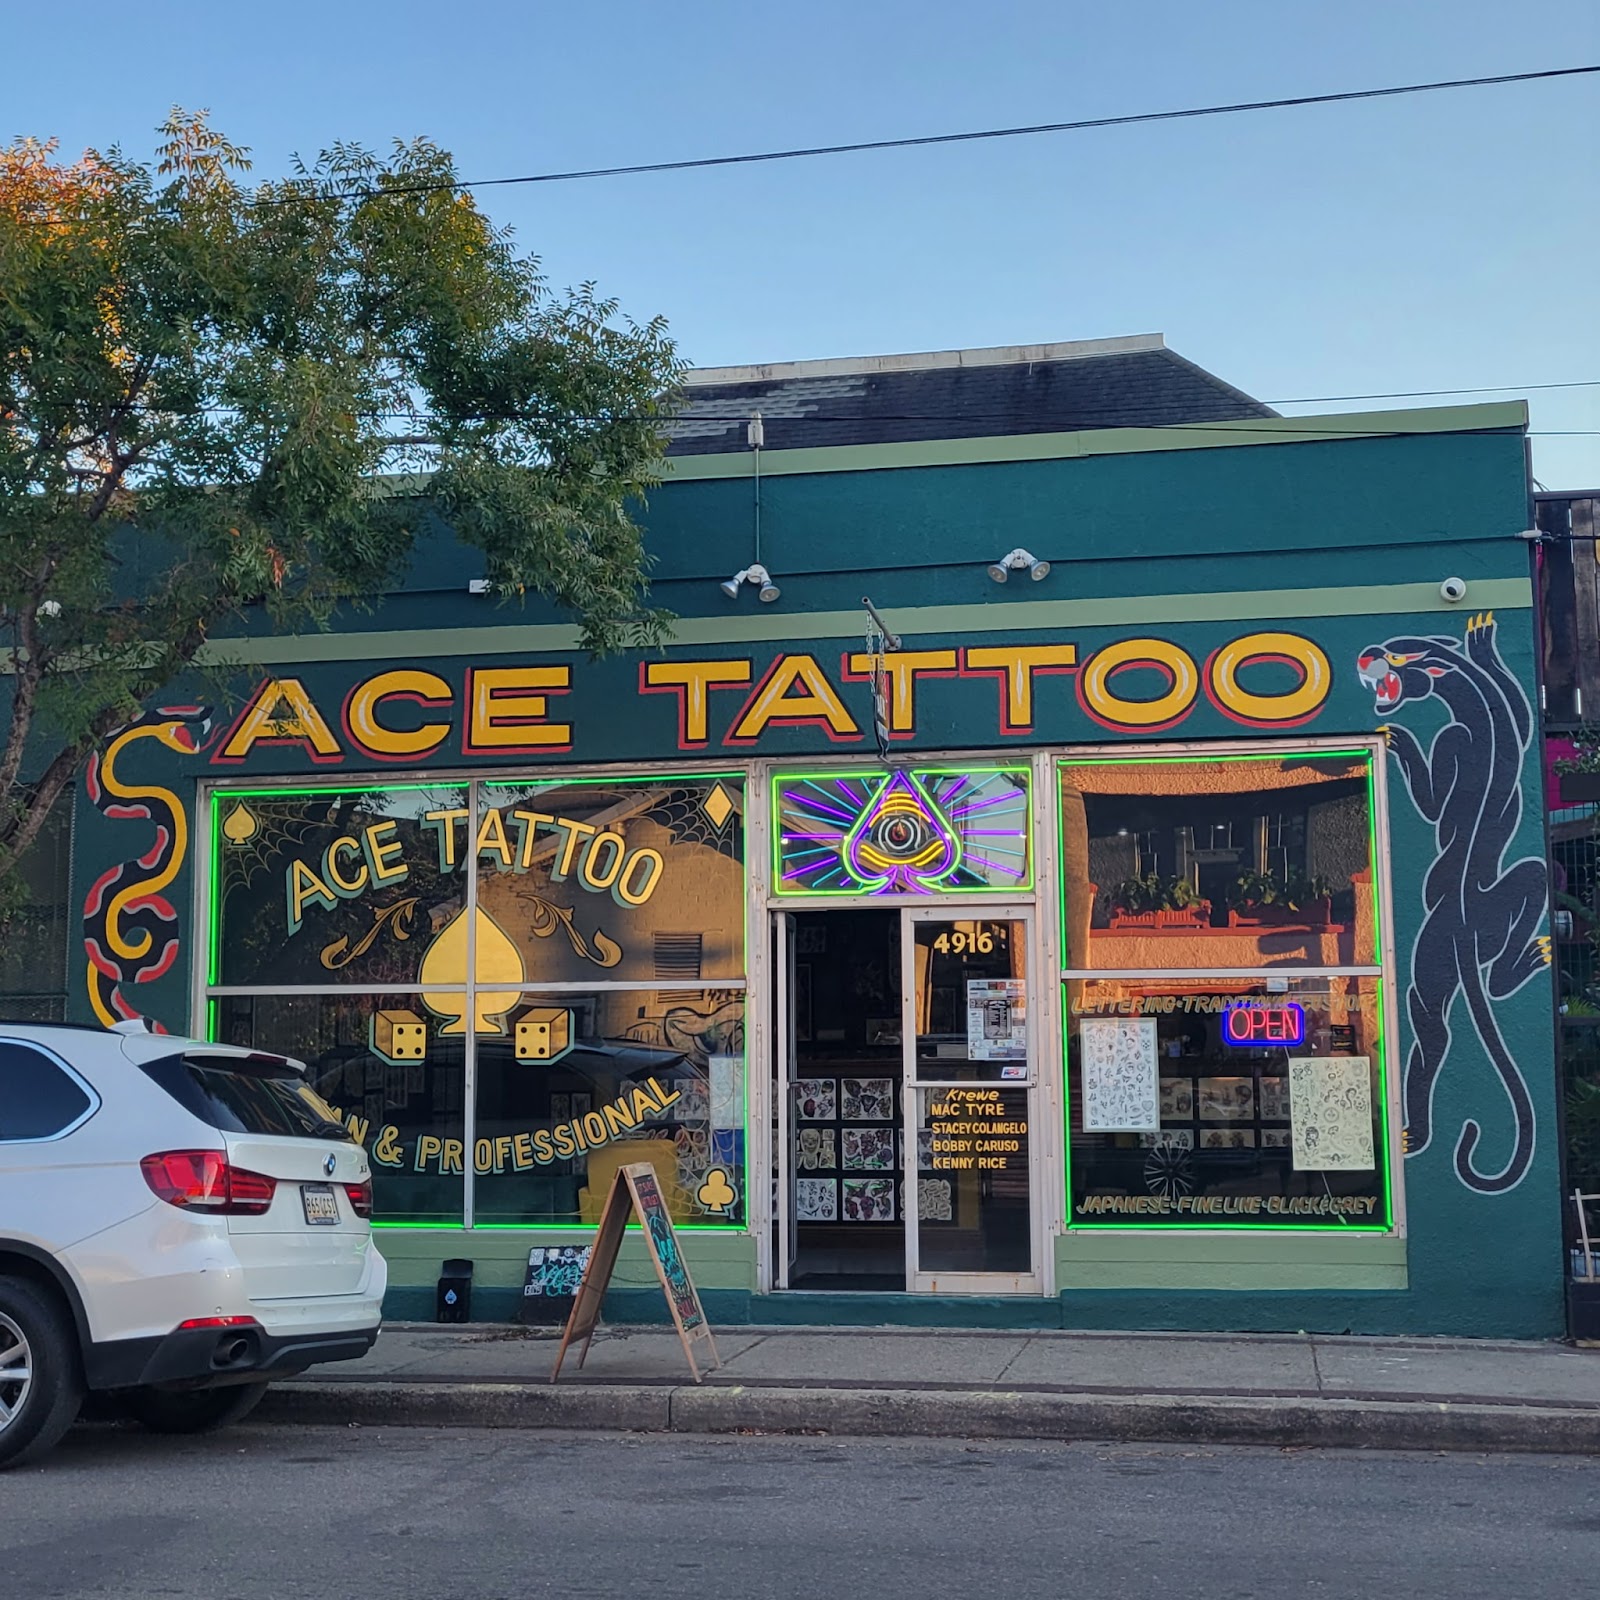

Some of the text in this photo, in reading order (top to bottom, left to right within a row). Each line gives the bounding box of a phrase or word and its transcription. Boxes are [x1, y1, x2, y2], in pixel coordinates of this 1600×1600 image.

[209, 665, 572, 763] ACE
[638, 633, 1331, 749] TATTOO
[286, 808, 665, 936] ACE TATTOO
[933, 932, 994, 954] 4916
[1229, 1008, 1300, 1041] OPEN
[945, 1088, 1000, 1102] Krewe
[931, 1103, 1005, 1116] MAC TYRE
[372, 1124, 404, 1168] &
[413, 1076, 684, 1176] PROFESSIONAL
[931, 1122, 1027, 1135] STACEY COLANGELO
[932, 1140, 1019, 1152] BOBBY CARUSO
[932, 1157, 1007, 1169] KENNY RICE
